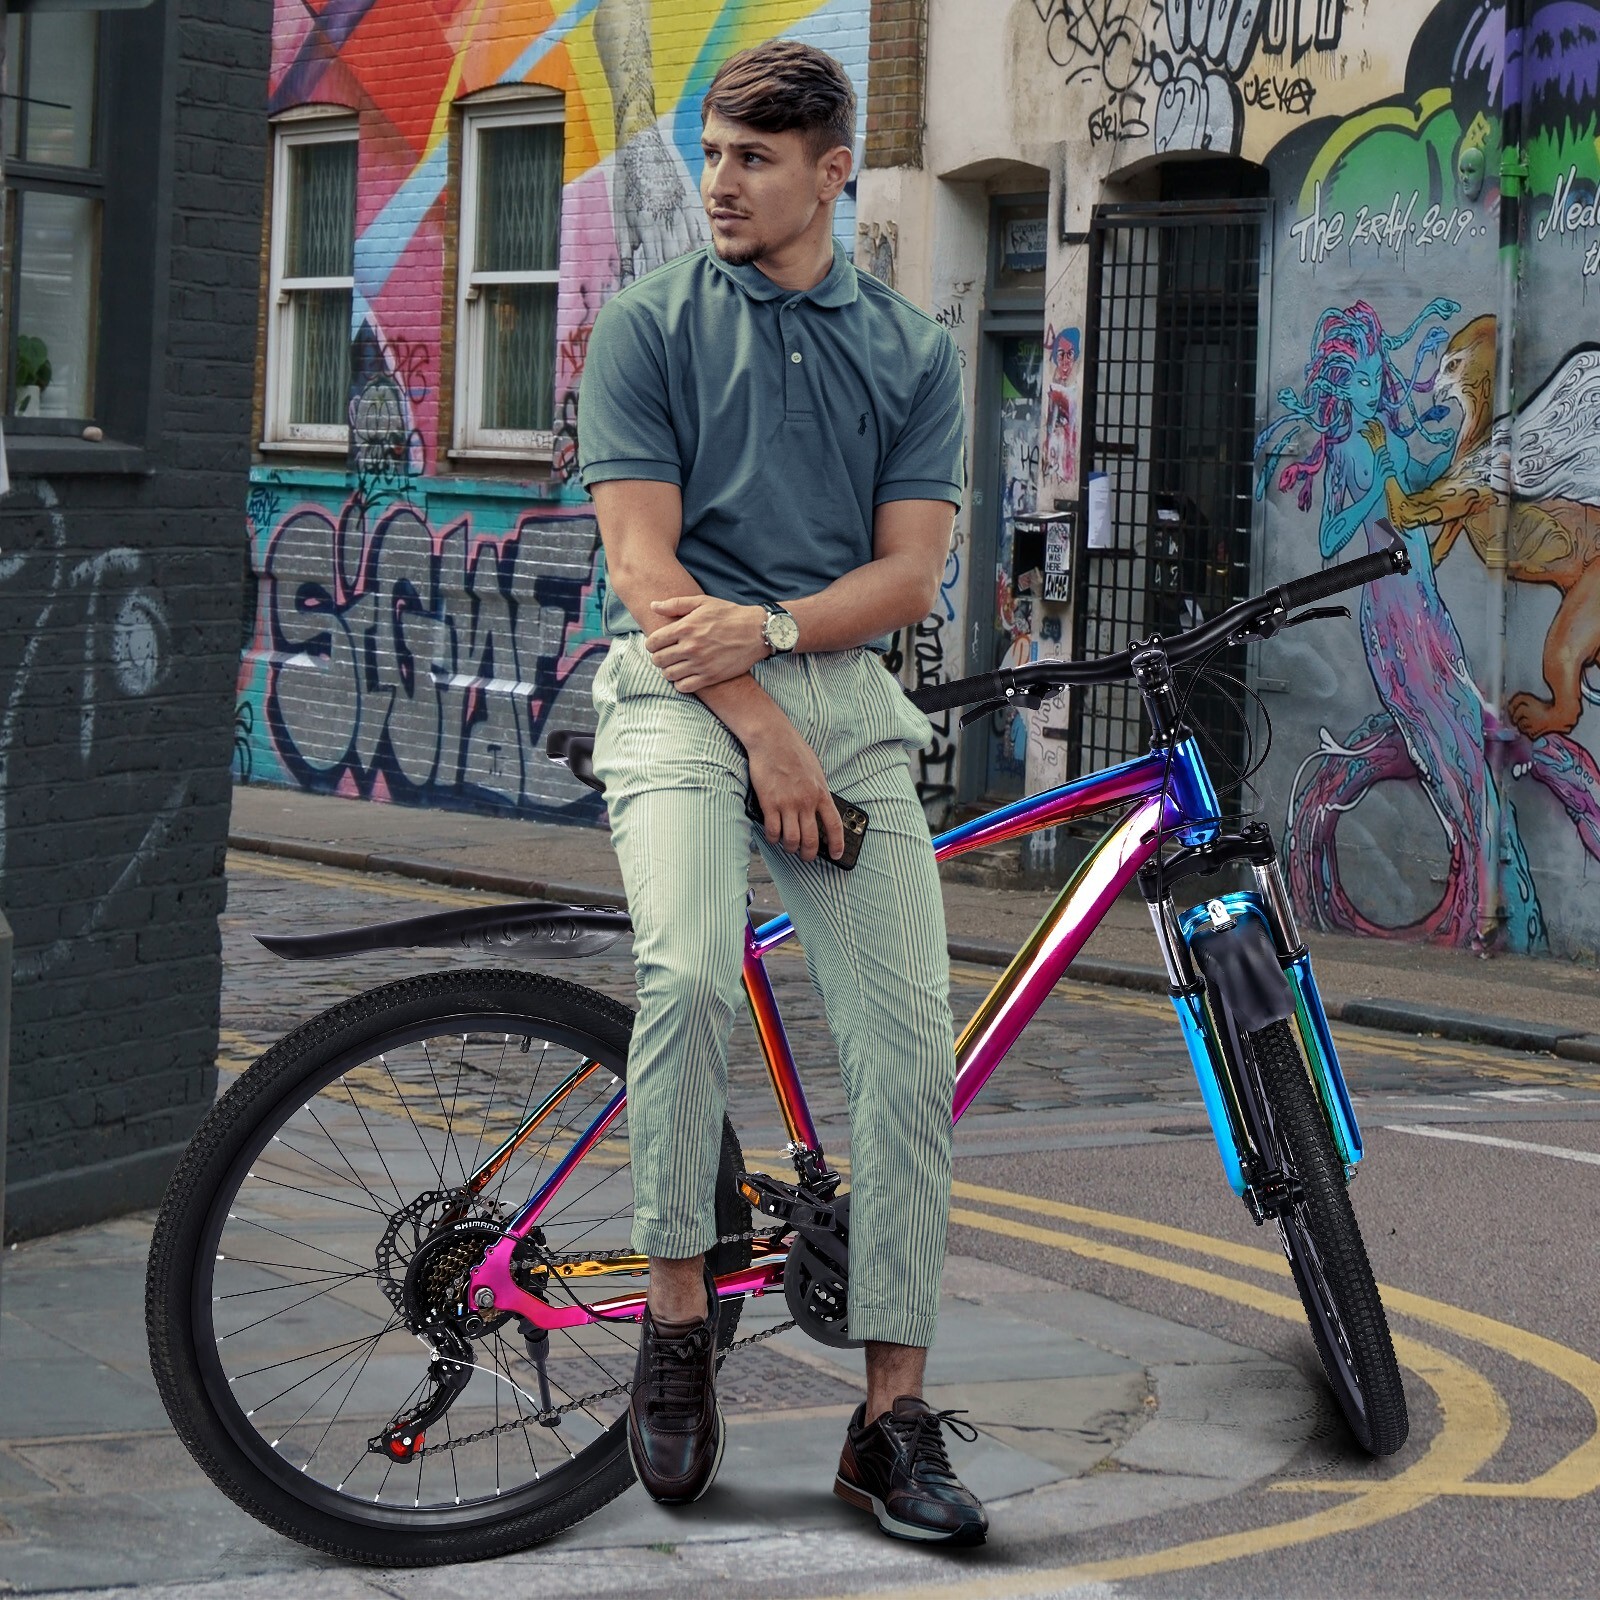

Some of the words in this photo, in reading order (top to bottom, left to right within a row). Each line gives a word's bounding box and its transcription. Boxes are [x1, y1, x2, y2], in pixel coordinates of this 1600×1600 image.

[1537, 163, 1600, 241] Med
[1290, 179, 1346, 263] The
[1048, 553, 1061, 561] WAS
[1046, 562, 1062, 572] HERE
[453, 1220, 500, 1231] SHIMANO
